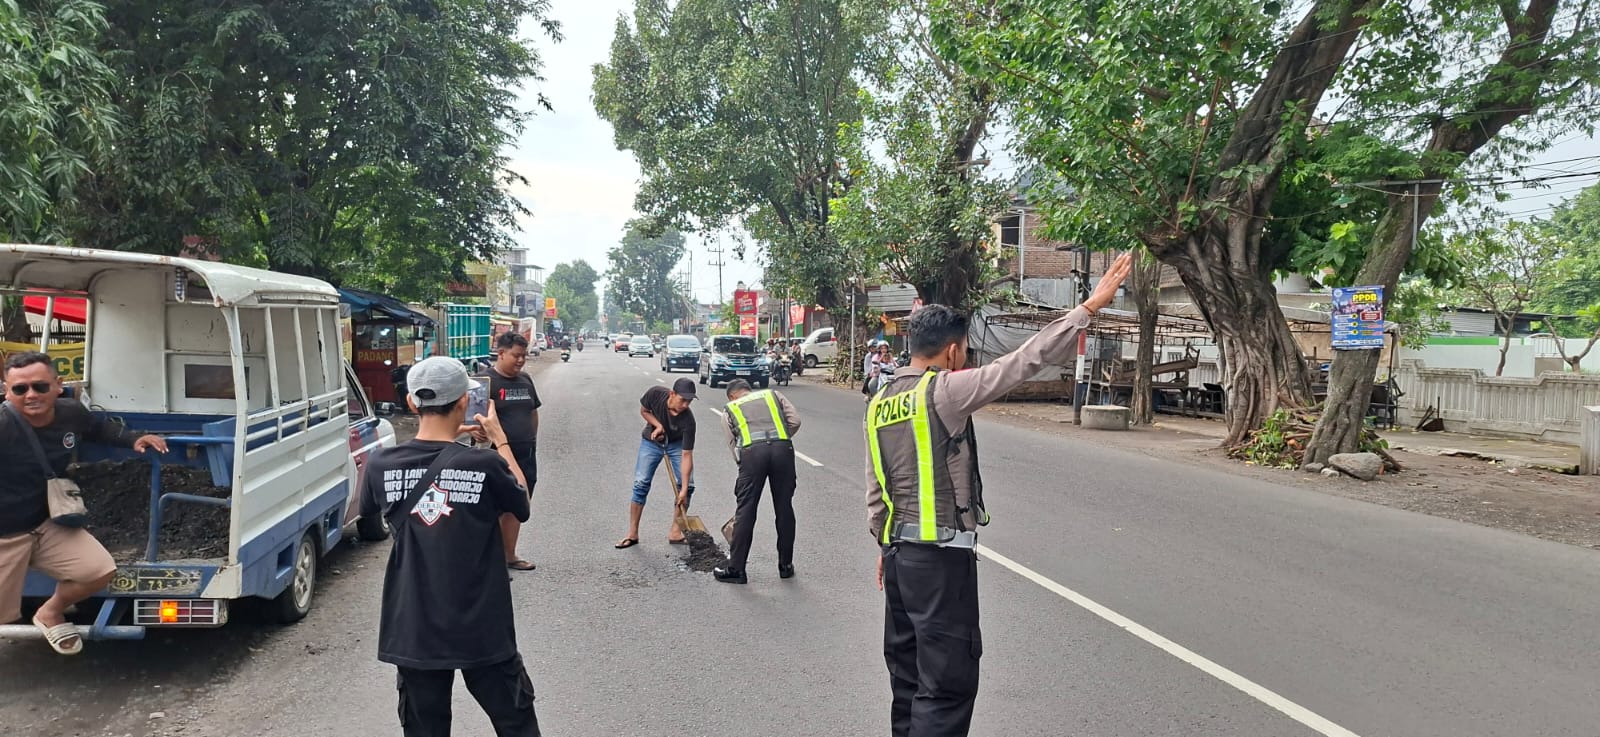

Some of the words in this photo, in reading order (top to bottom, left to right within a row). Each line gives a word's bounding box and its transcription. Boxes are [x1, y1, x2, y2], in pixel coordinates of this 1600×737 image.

[358, 351, 394, 360] PADANG
[874, 392, 916, 426] POLISI
[441, 469, 486, 482] SIDOARJO
[440, 480, 483, 493] SIDOARJO
